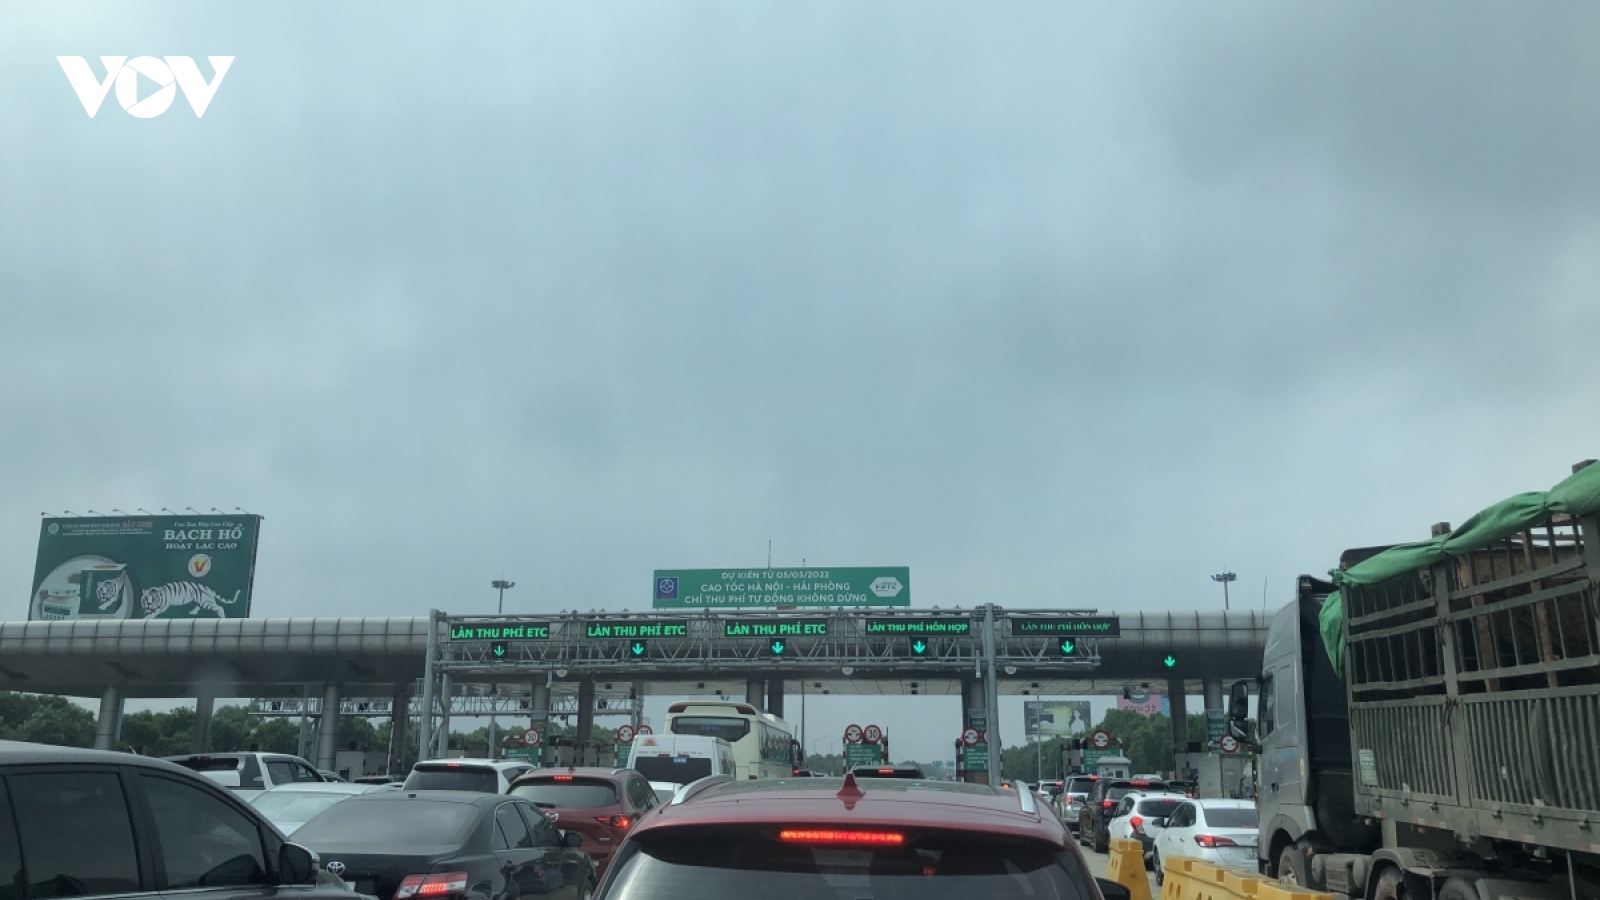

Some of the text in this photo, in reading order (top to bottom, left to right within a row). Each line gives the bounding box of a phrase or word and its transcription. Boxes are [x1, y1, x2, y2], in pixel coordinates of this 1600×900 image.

[163, 529, 213, 542] BẠCH
[722, 569, 829, 581] DỰ KIẾN TỪ 05/05/2022
[701, 584, 722, 592] CAO
[725, 581, 745, 592] TỐC
[747, 581, 762, 591] HÀ
[764, 581, 784, 592] NỘI
[793, 580, 811, 591] HẢI
[814, 580, 850, 591] PHÒNG
[684, 591, 867, 605] CHỈ THU PHÍ TỰ ĐỘNG KHÔNG DỪNG
[451, 626, 548, 639] LÀN THU PHÍ ETC
[587, 624, 686, 636] LÀN THU PHÍ ETC
[727, 622, 826, 635] LÀN THU PHÍ ETC
[867, 621, 885, 632] LÀN
[887, 623, 906, 632] THU
[907, 621, 924, 632] PHÍ
[948, 623, 968, 634] HỢP
[527, 732, 537, 742] 30
[868, 729, 878, 739] 30
